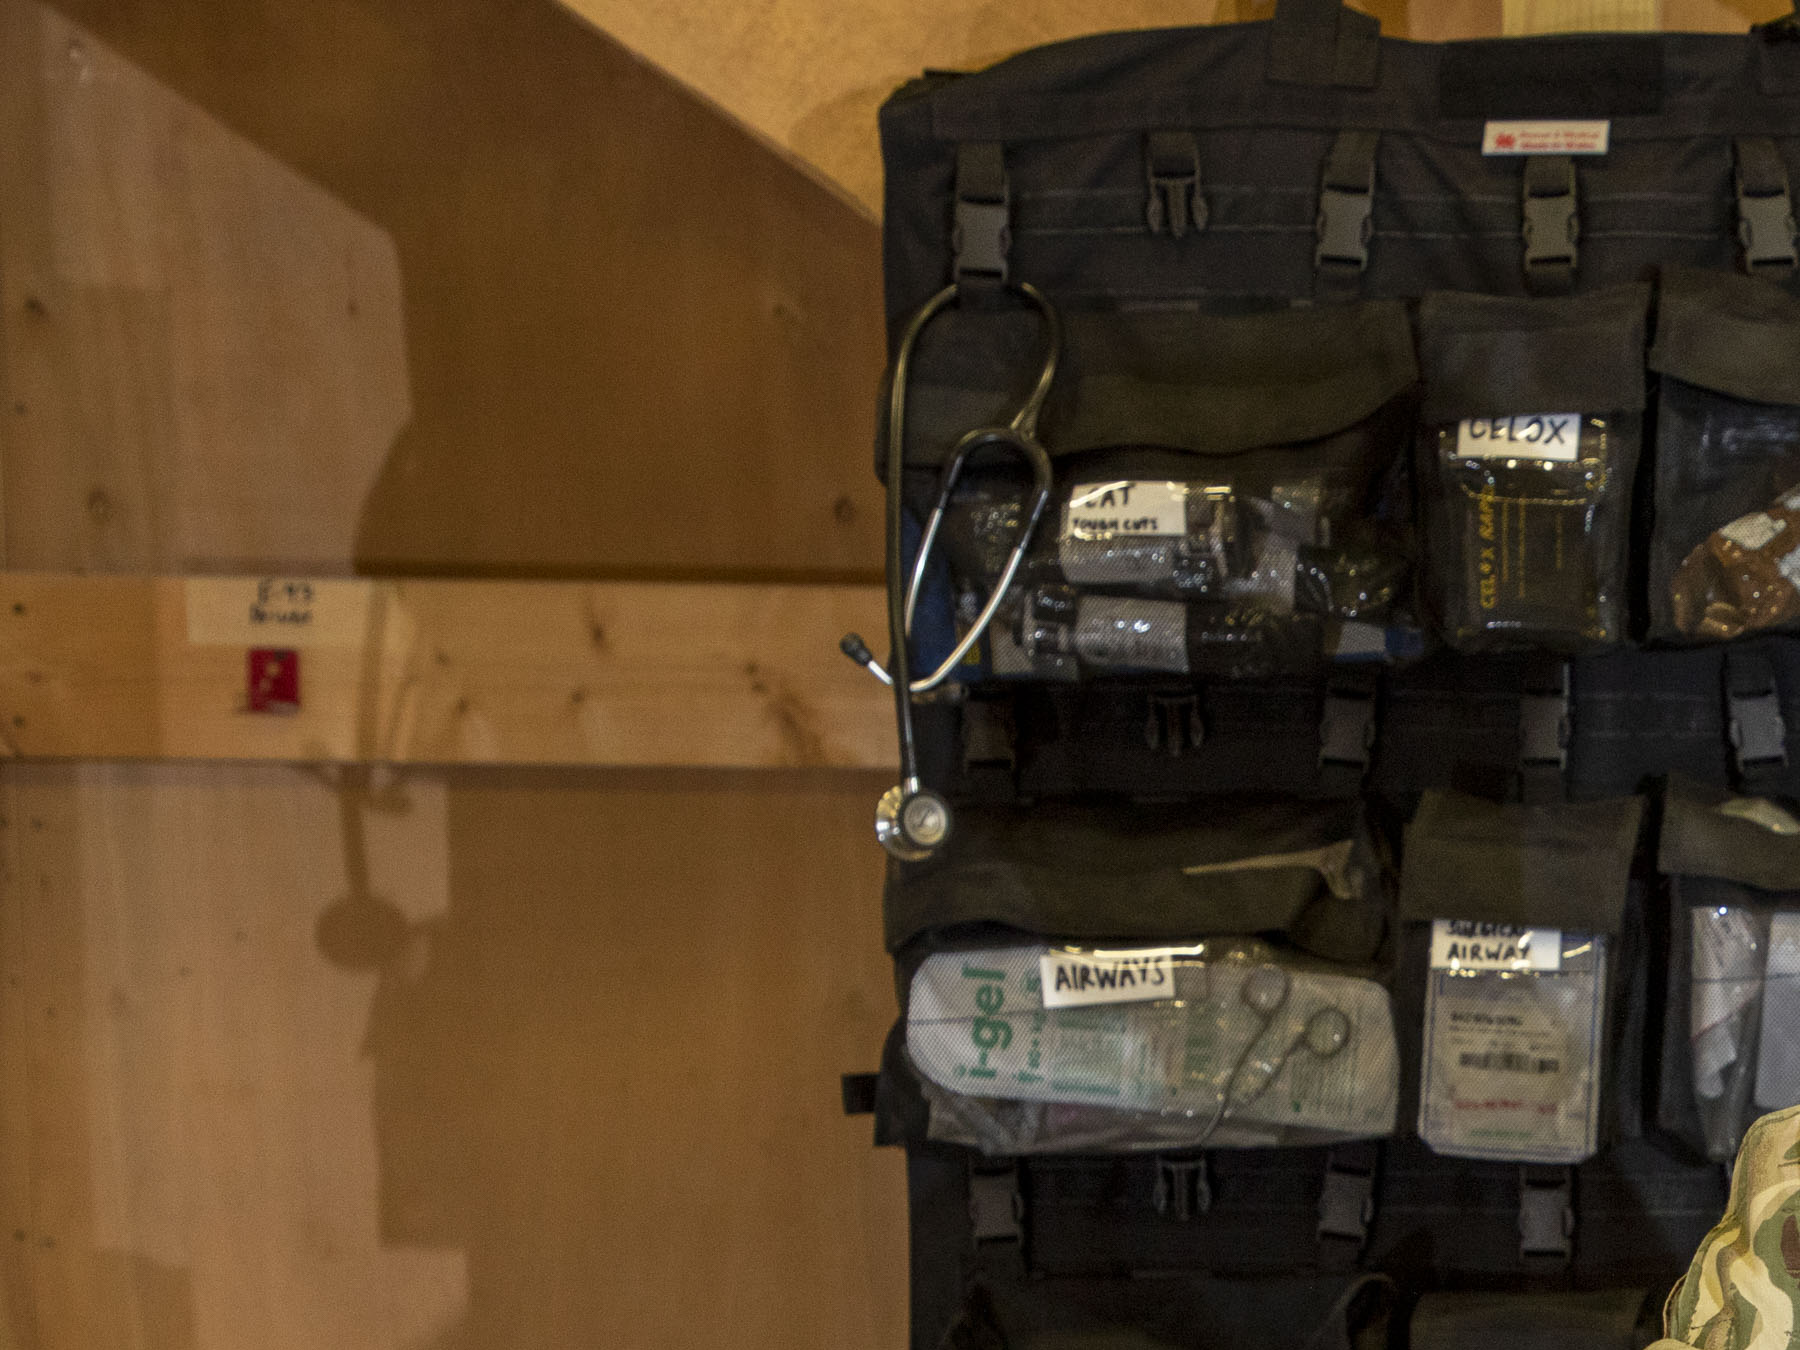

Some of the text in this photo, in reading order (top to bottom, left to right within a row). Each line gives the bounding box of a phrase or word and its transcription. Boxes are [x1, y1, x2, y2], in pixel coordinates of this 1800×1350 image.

[1470, 416, 1569, 445] CELOX
[1085, 484, 1134, 508] CAT
[1123, 518, 1159, 531] CUTS
[1447, 942, 1532, 962] AIRWAY
[1055, 956, 1166, 992] AIRWAYS
[953, 965, 1014, 1079] i-gel
